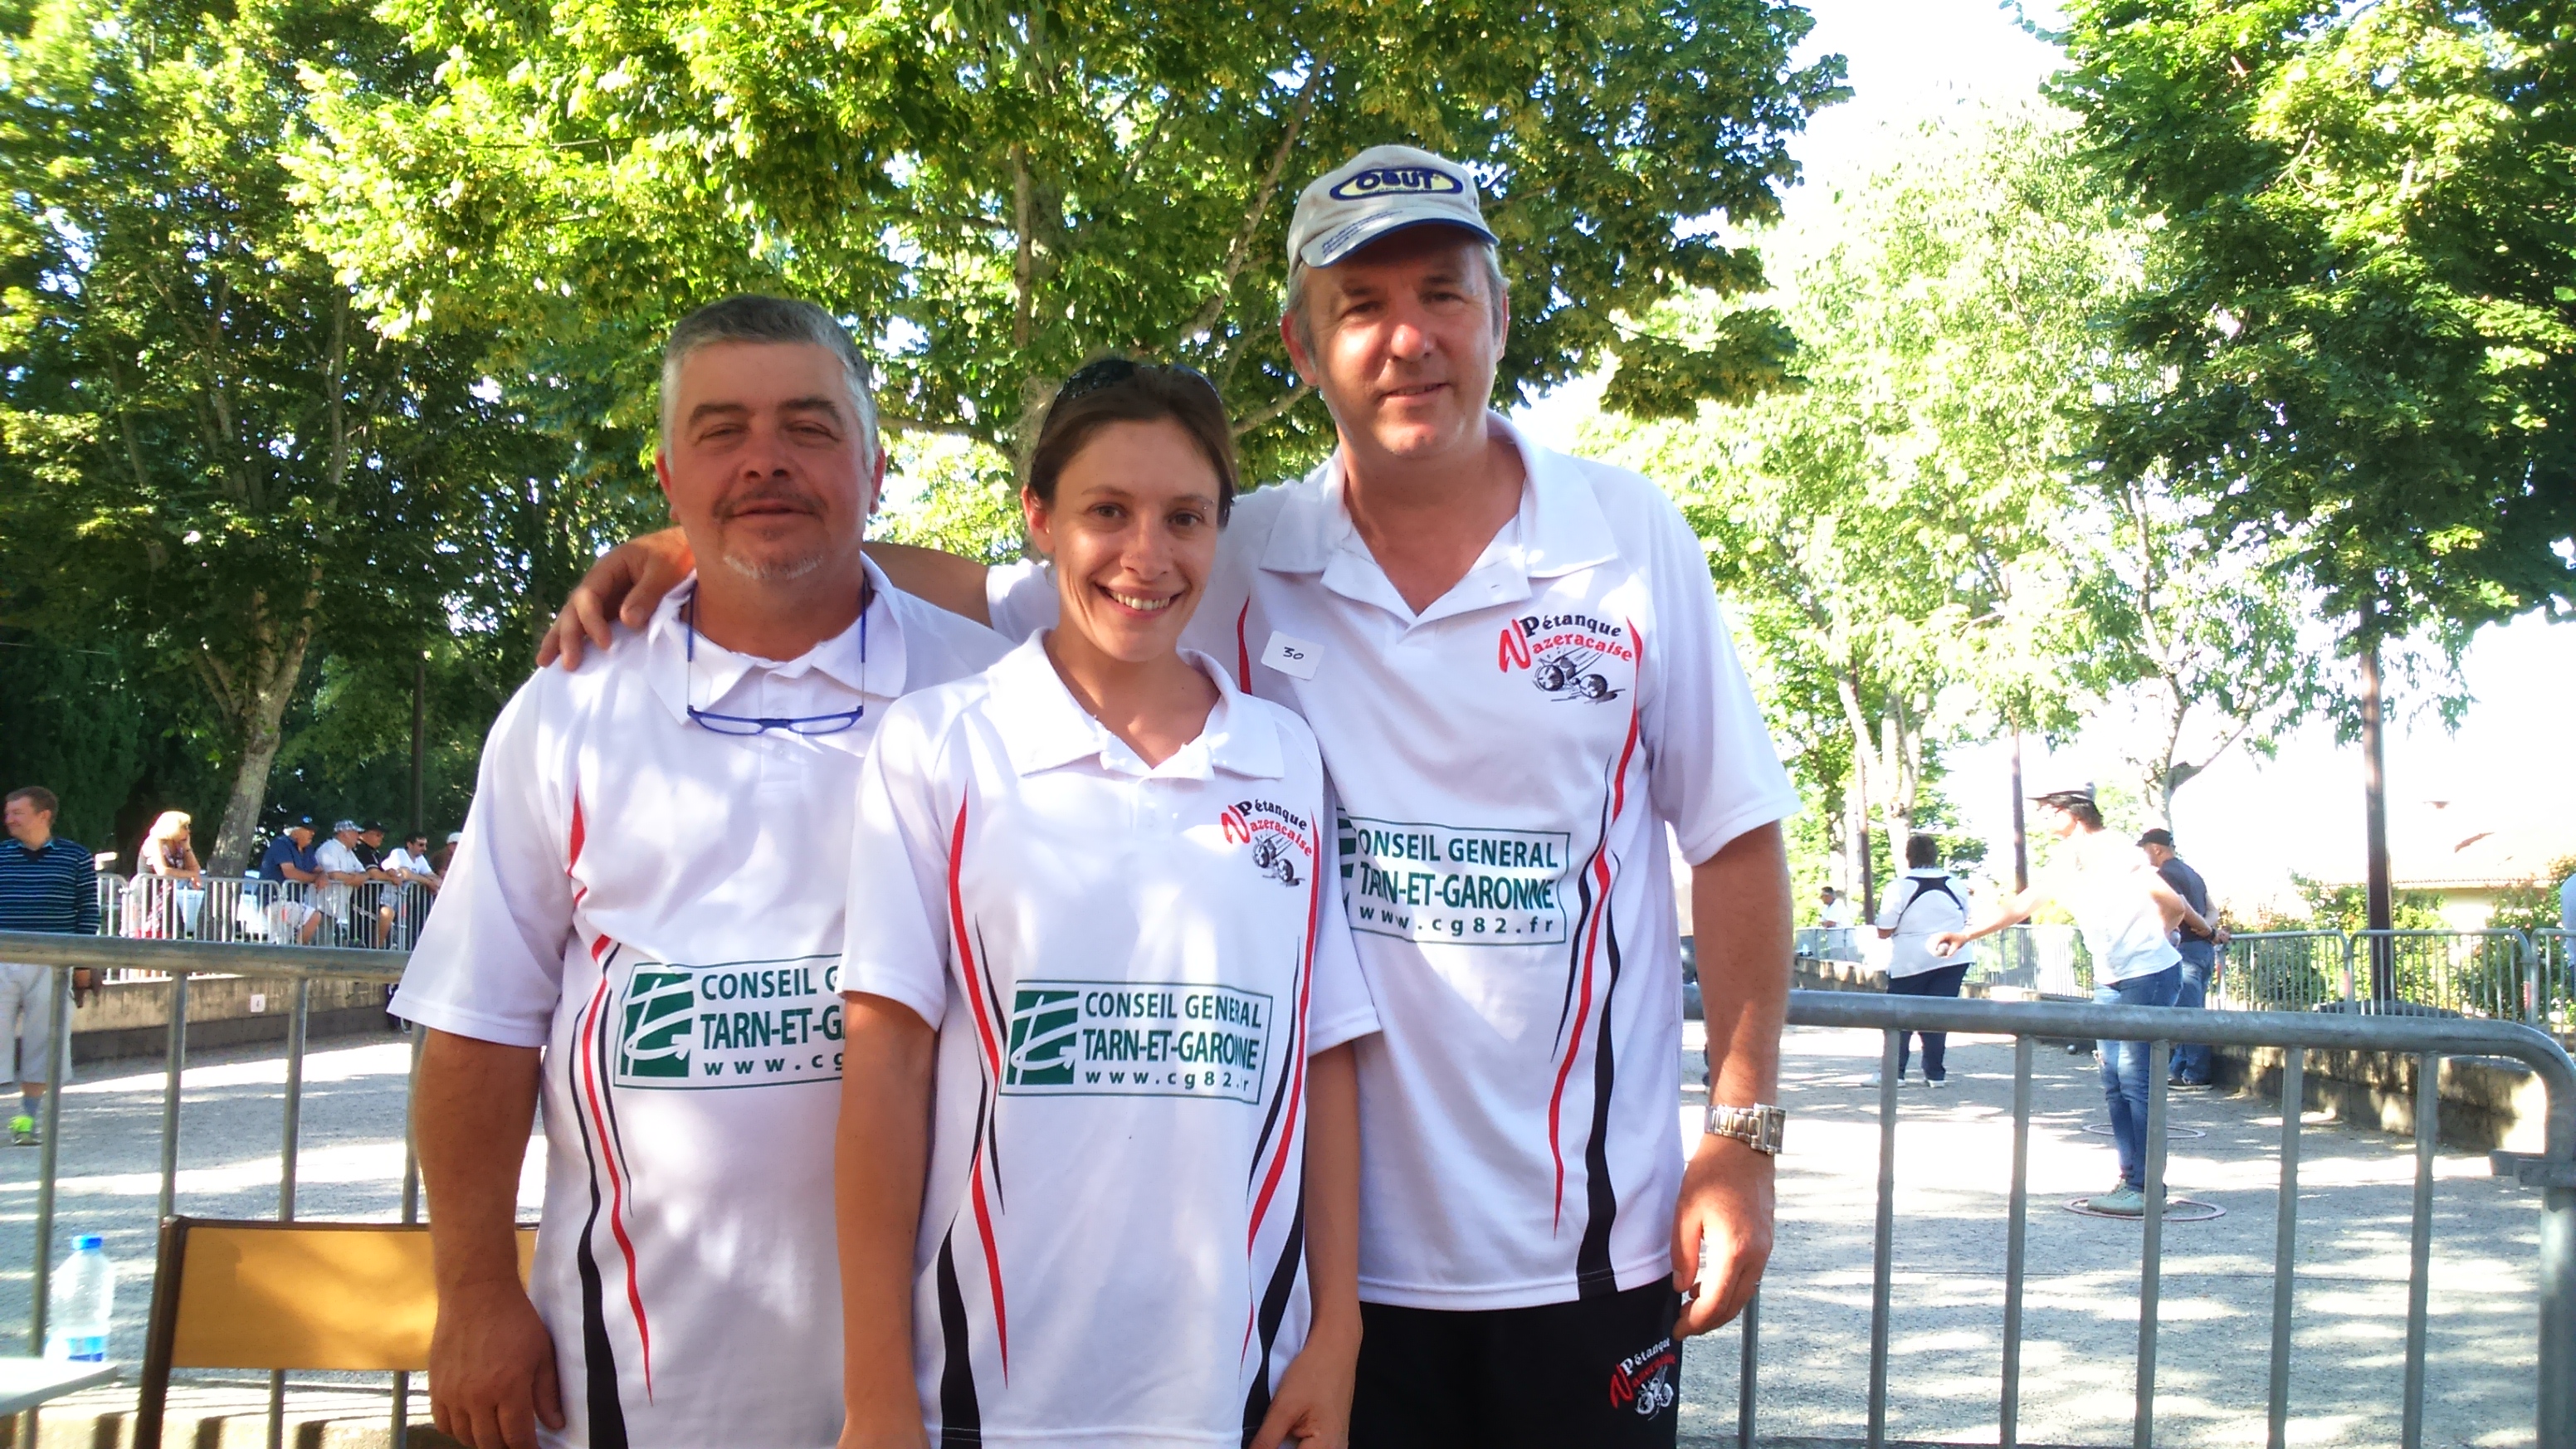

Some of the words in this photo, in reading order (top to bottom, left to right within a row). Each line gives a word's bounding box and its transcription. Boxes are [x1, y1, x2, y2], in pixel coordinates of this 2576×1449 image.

[1520, 614, 1622, 637] Pétanque
[1283, 646, 1304, 660] 30
[1498, 618, 1633, 673] Nazeracaise
[1221, 804, 1311, 856] Nazeracaise
[1235, 798, 1307, 830] Pétanque
[1358, 828, 1441, 861] ONSEIL
[1448, 838, 1559, 868] GENERAL
[701, 968, 817, 1000] CONSEIL
[700, 1004, 846, 1050] TARN-ET-G
[1085, 992, 1178, 1018] CONSEIL
[1184, 995, 1261, 1029] GENERAL
[704, 1054, 842, 1076] www.cg
[1086, 1070, 1249, 1092] www.cg82.r
[1620, 1337, 1671, 1377] Pétanqu
